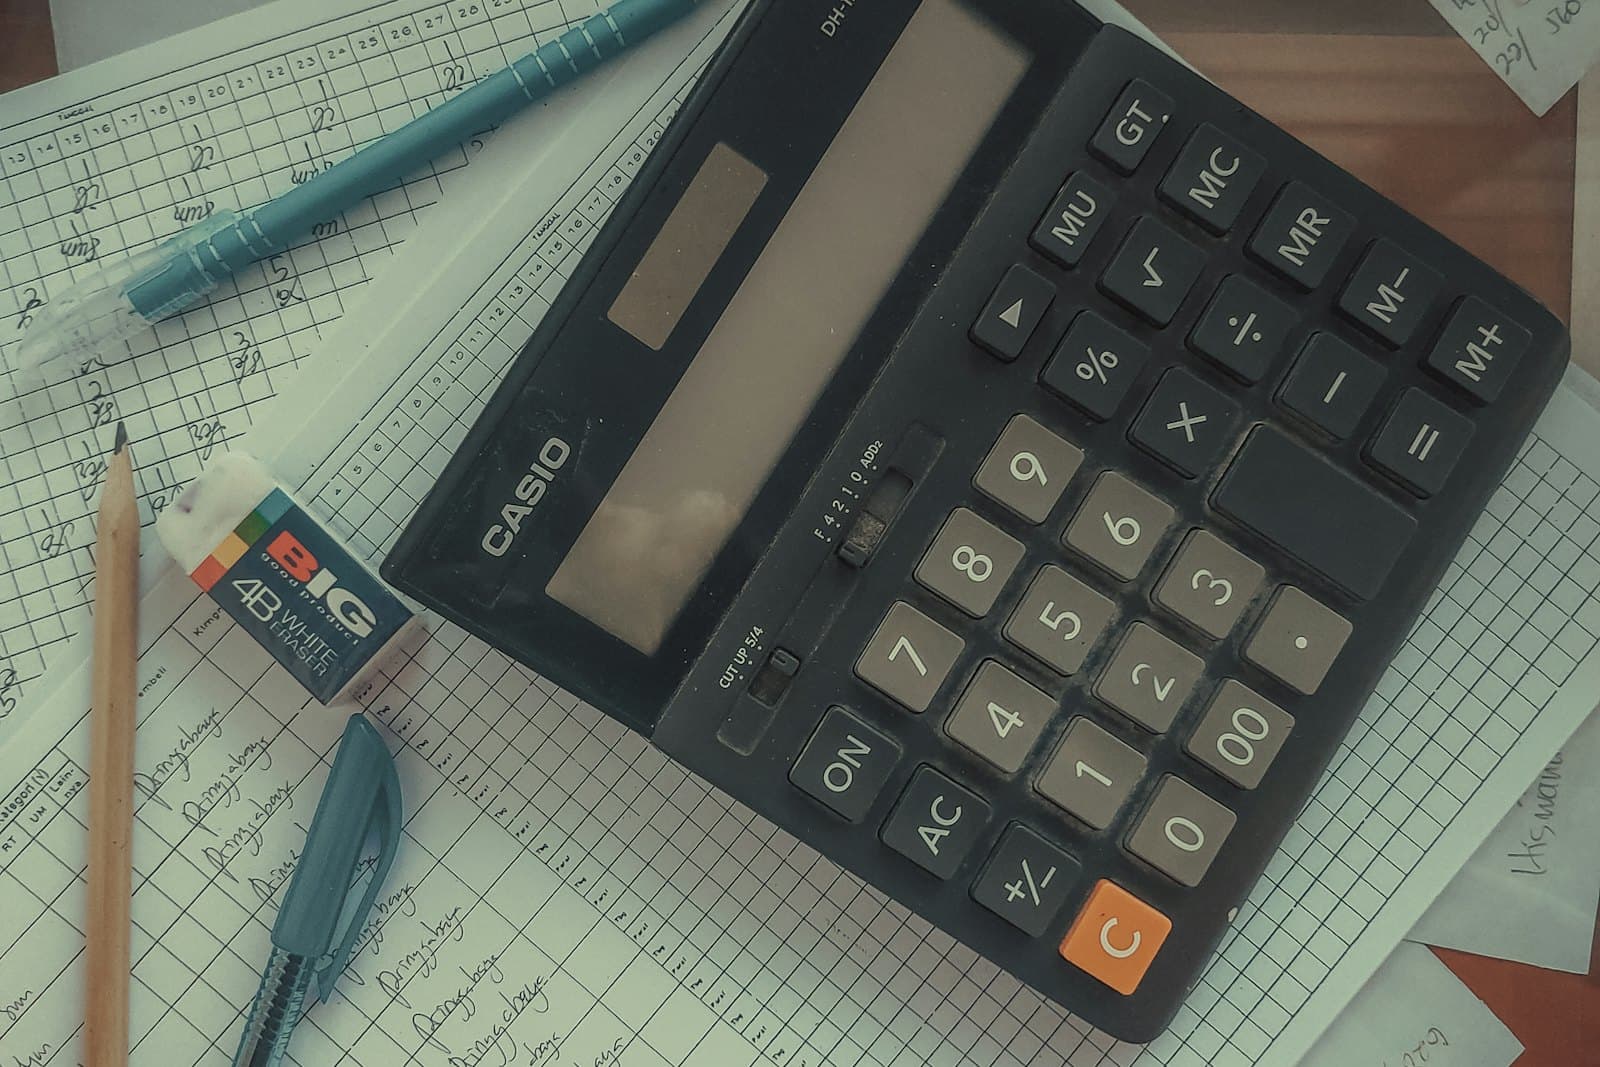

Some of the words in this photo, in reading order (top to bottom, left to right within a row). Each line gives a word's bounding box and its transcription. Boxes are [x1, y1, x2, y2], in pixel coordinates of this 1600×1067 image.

[8, 153, 26, 164] 13
[37, 144, 54, 153] 14
[64, 133, 82, 144] 15
[92, 124, 111, 134] 16
[121, 113, 138, 125] 17
[150, 105, 168, 115] 18
[179, 95, 196, 106] 19
[208, 85, 225, 98] 20
[236, 77, 253, 89] 21
[266, 66, 285, 79] 22
[296, 57, 316, 69] 23
[358, 36, 378, 50] 25
[391, 26, 414, 40] 26
[424, 14, 443, 28] 27
[1116, 99, 1152, 145] GT
[1189, 147, 1240, 209] MC
[1051, 190, 1096, 245] MU
[1278, 208, 1330, 266] MR
[353, 465, 362, 475] 5
[374, 443, 382, 452] 6
[393, 420, 400, 428] 7
[432, 377, 441, 387] 9
[450, 351, 464, 365] 10
[470, 331, 483, 343] 11
[489, 307, 504, 322] 12
[509, 286, 523, 299] 13
[529, 264, 542, 277] 14
[548, 241, 562, 255] 15
[568, 219, 582, 233] 16
[588, 196, 601, 211] 17
[607, 175, 622, 189] 18
[627, 153, 641, 166] 19
[646, 130, 661, 146] 20
[1455, 324, 1503, 382] M+
[1010, 452, 1047, 486] 9
[479, 437, 573, 561] CASIO
[814, 528, 824, 539] F
[824, 514, 835, 525] 4
[832, 500, 845, 512] 2
[842, 487, 853, 495] 1
[850, 472, 862, 481] 0
[1103, 512, 1140, 545] 6
[260, 551, 300, 588] good
[266, 529, 377, 640] BIG
[952, 546, 993, 582] 8
[1192, 569, 1232, 605] 3
[232, 578, 282, 622] 4B
[1039, 602, 1081, 640] 5
[268, 620, 328, 679] ERASER
[280, 608, 339, 664] WHITE
[719, 662, 738, 689] CUT
[734, 646, 748, 665] UP
[744, 625, 765, 648] 5/4
[888, 636, 927, 676] 7
[1132, 664, 1175, 701] 2
[987, 702, 1024, 738] 4
[1217, 708, 1269, 765] 00
[824, 735, 871, 792] ON
[1076, 761, 1112, 786] 1
[29, 806, 47, 823] UM
[918, 796, 961, 856] AC
[1165, 817, 1204, 851] 0
[2, 835, 18, 851] RT
[1100, 918, 1141, 958] C
